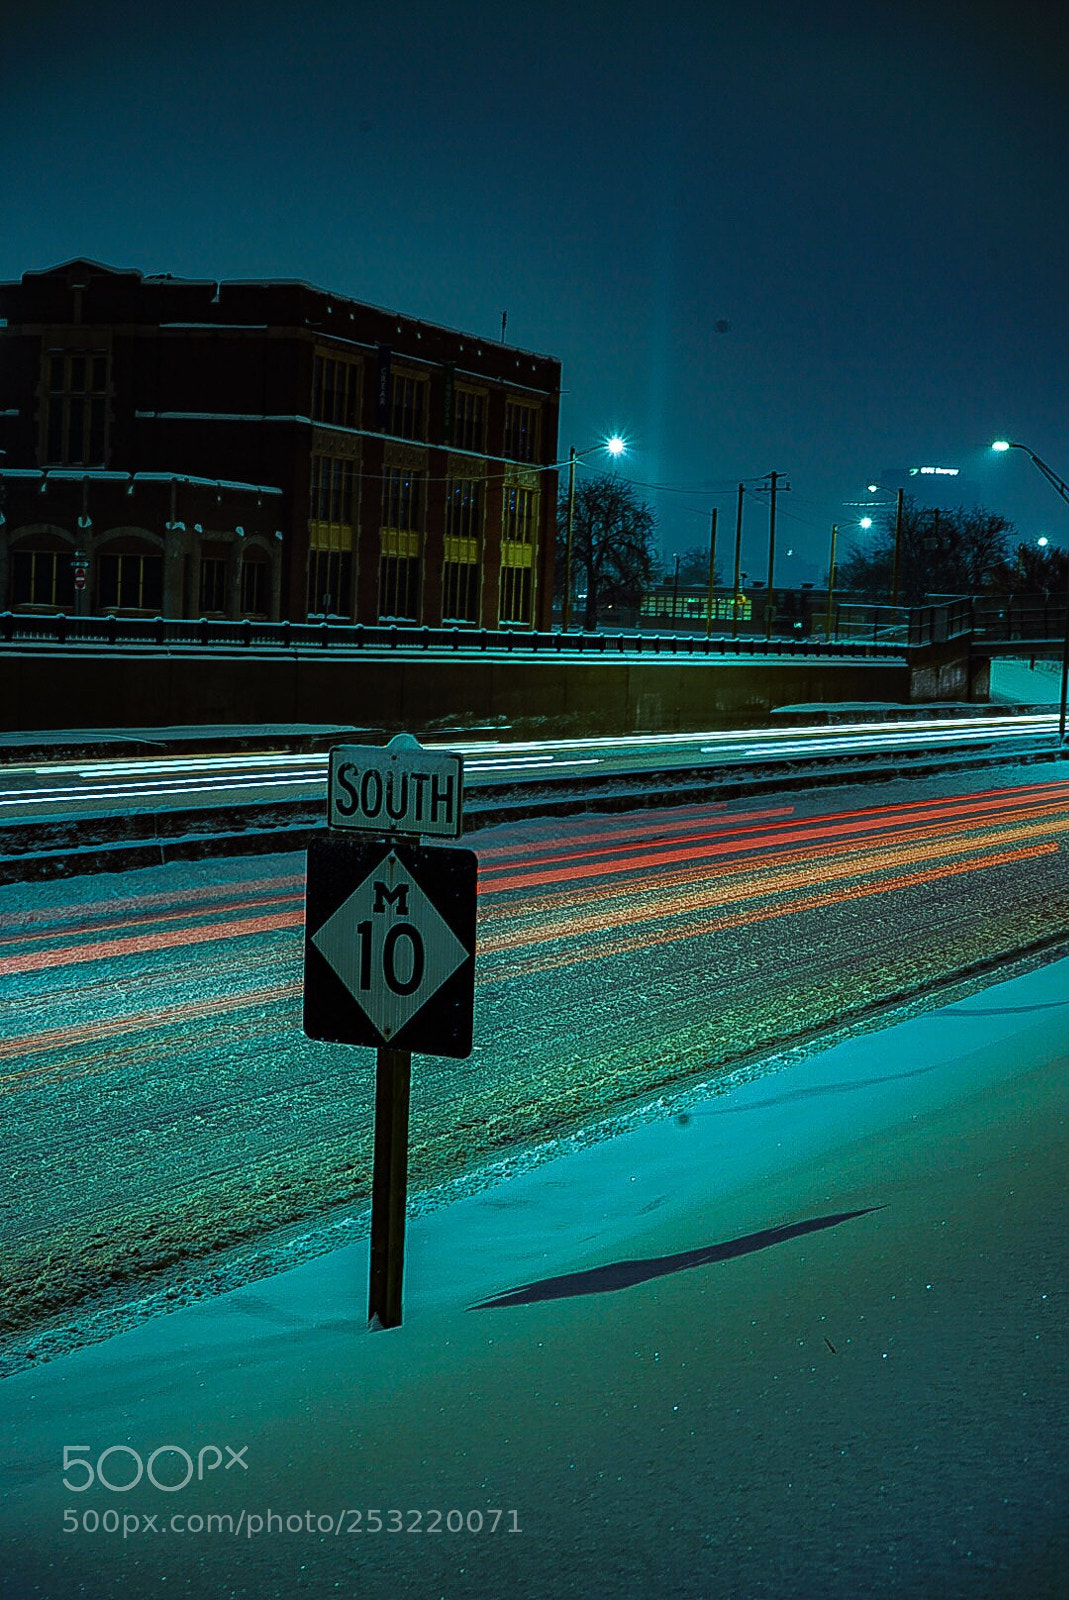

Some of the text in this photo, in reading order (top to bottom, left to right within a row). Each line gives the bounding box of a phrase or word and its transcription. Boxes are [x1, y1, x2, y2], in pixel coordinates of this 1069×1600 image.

[336, 763, 453, 823] SOUTH
[373, 881, 409, 915] M
[357, 920, 425, 996] 10
